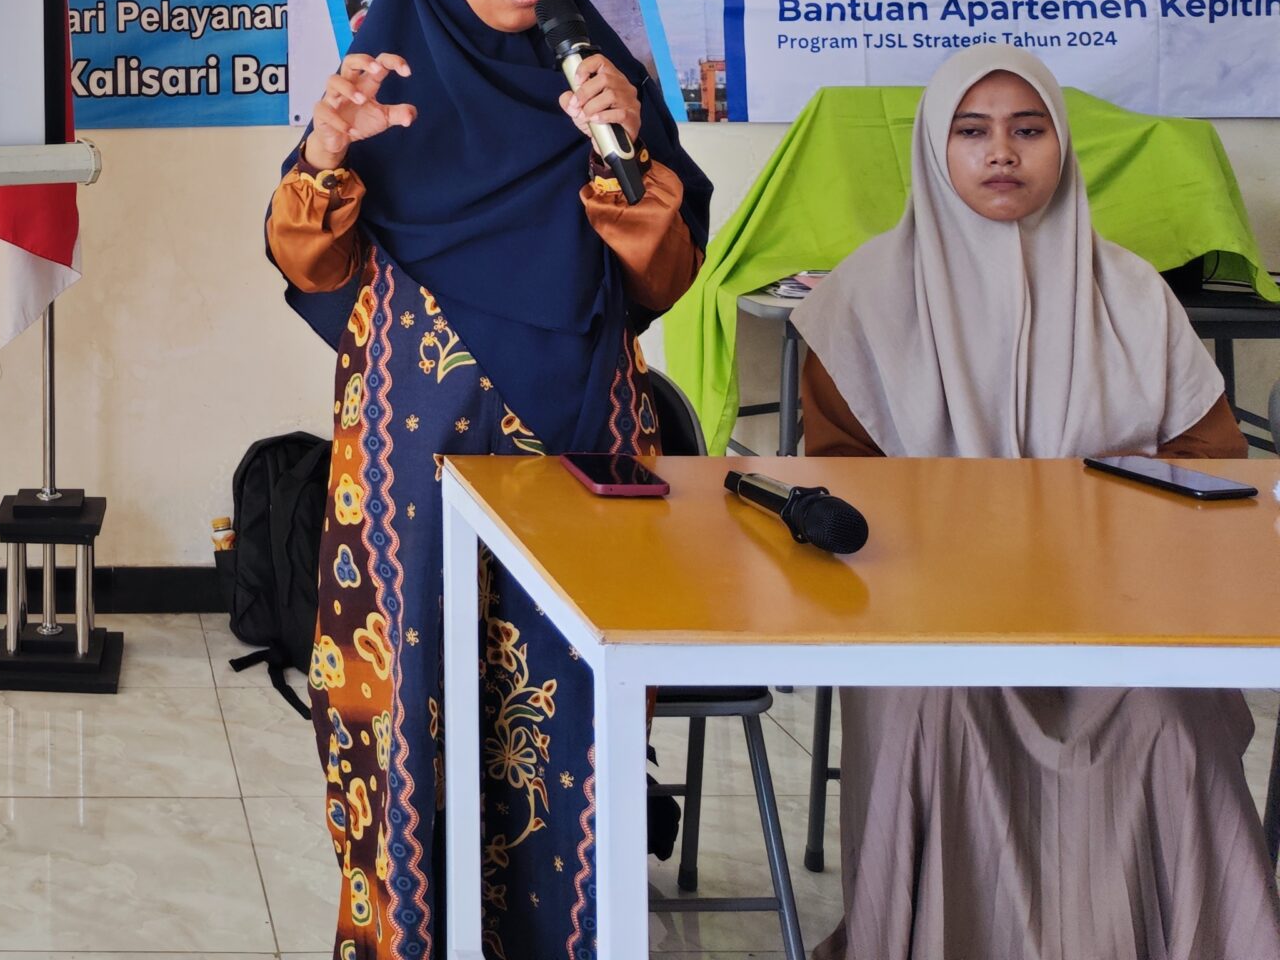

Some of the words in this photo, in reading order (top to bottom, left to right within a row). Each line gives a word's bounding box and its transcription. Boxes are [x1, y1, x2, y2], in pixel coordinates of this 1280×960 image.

[778, 34, 858, 52] Program
[863, 33, 908, 49] TJSL
[1001, 31, 1062, 47] Tahun
[1066, 31, 1118, 47] 2024
[70, 55, 219, 97] Kalisari
[232, 54, 288, 95] Ba
